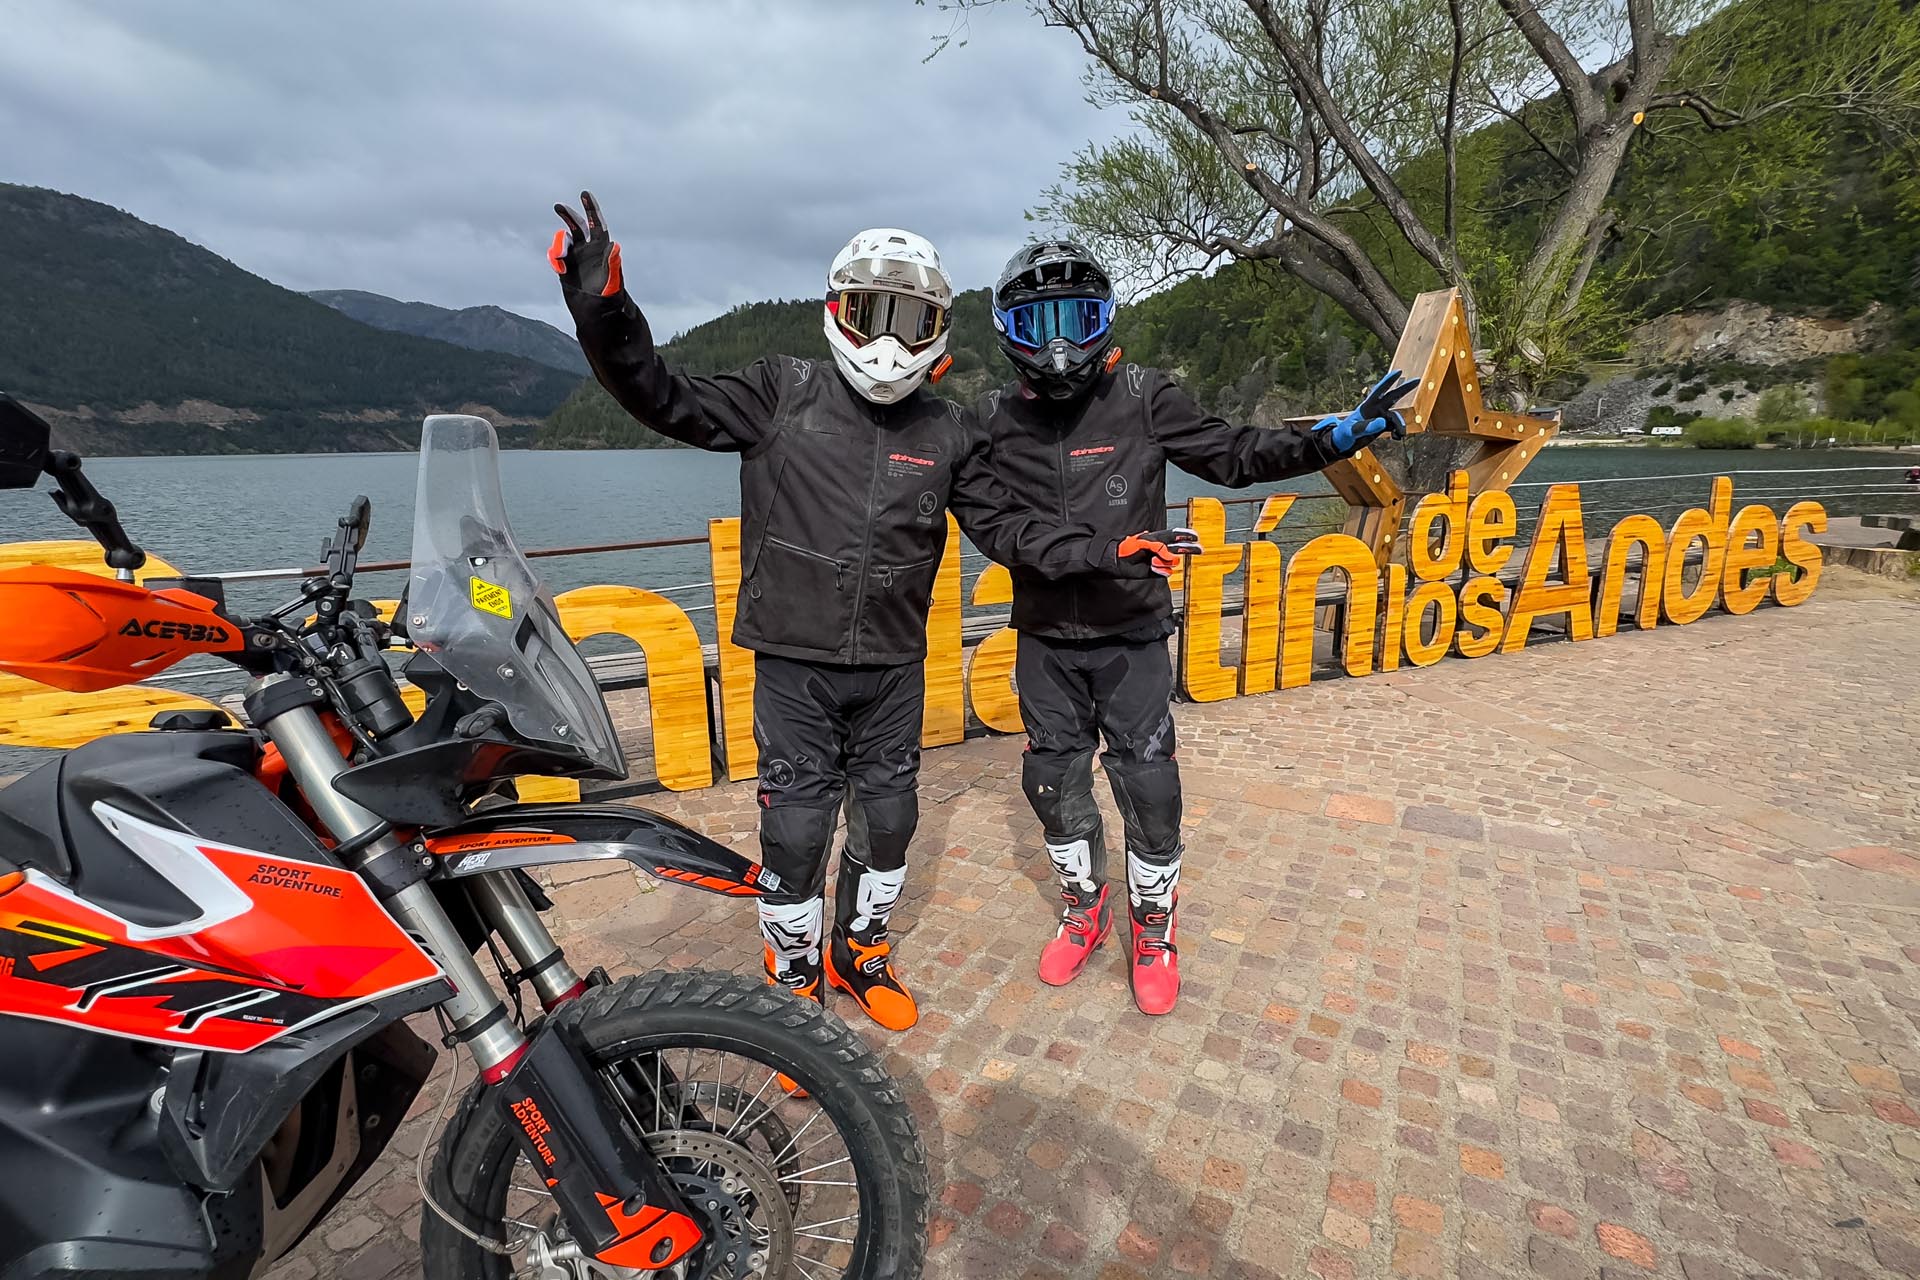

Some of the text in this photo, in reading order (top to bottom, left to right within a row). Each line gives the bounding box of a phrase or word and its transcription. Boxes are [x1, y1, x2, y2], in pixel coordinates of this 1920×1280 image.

[1409, 468, 1516, 582] de
[1379, 475, 1828, 672] los Andes
[475, 589, 504, 605] PAVEMENT
[458, 836, 552, 850] SPORT ADVENTURE
[256, 864, 311, 880] SPORT
[522, 1097, 552, 1134] SPORT
